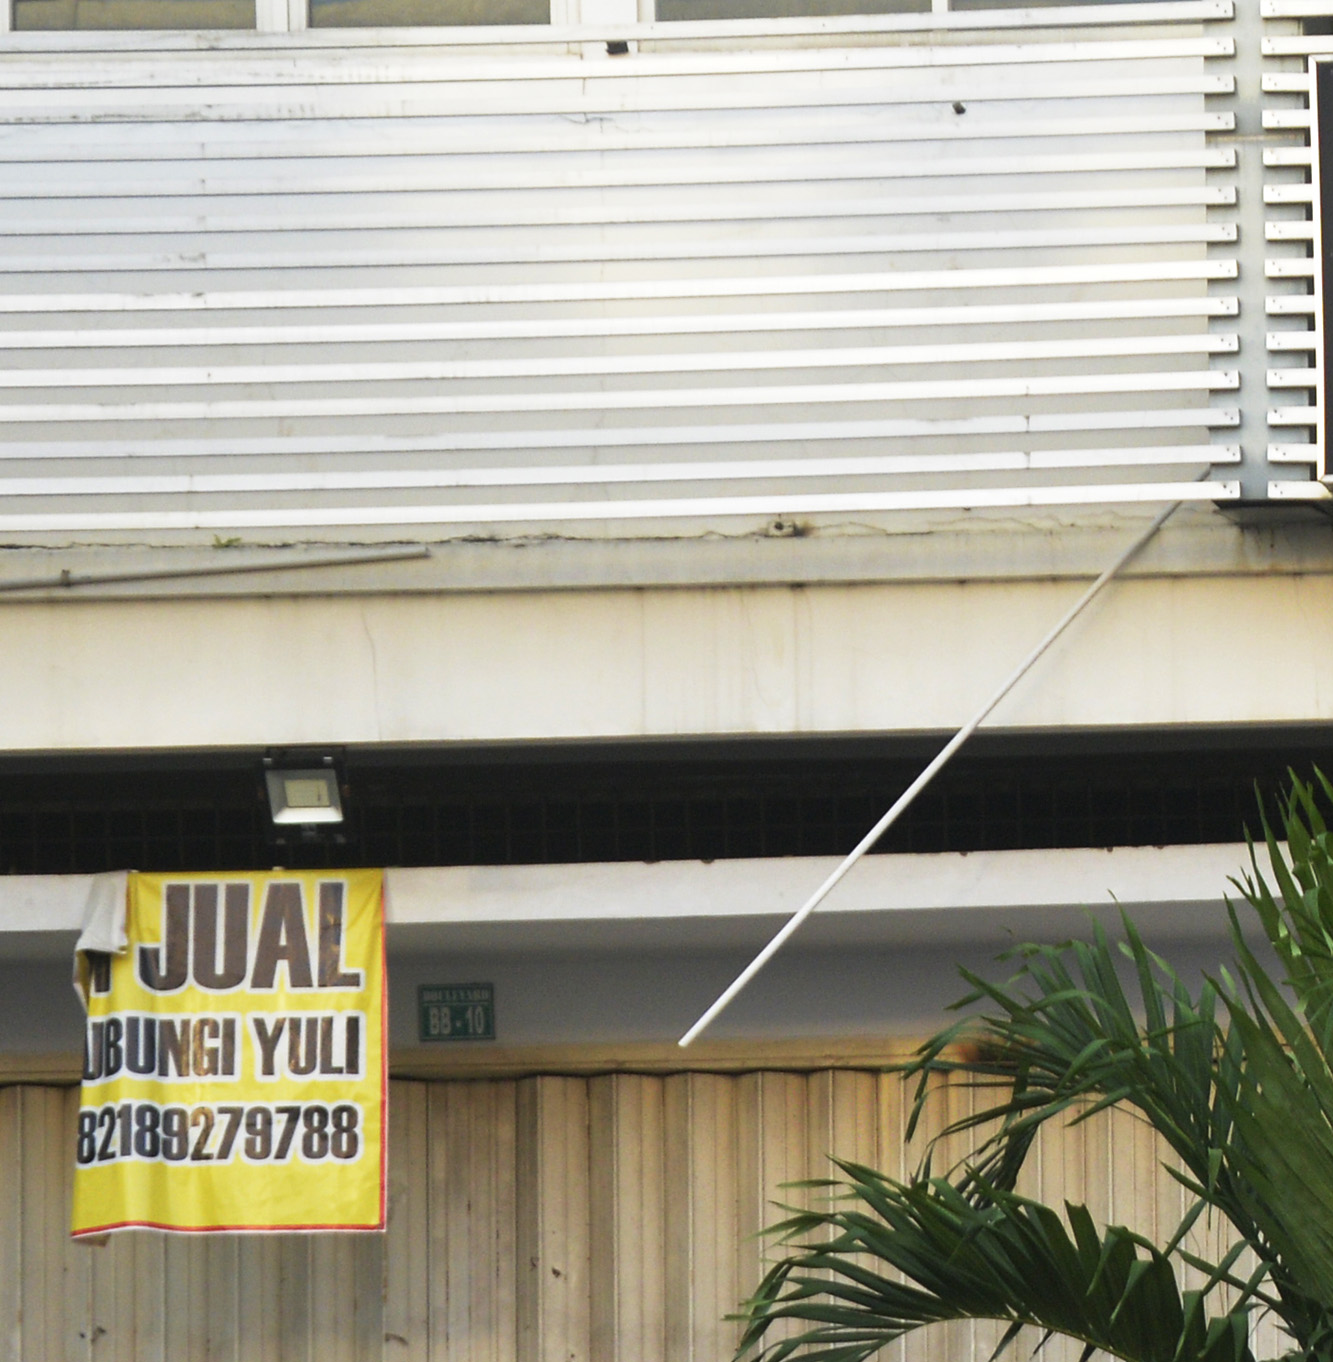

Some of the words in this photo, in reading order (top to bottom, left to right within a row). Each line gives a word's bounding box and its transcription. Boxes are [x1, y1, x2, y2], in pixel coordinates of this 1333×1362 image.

[138, 882, 361, 991] JUAL
[255, 1015, 360, 1076] YULI
[77, 1103, 359, 1165] 82189279788
